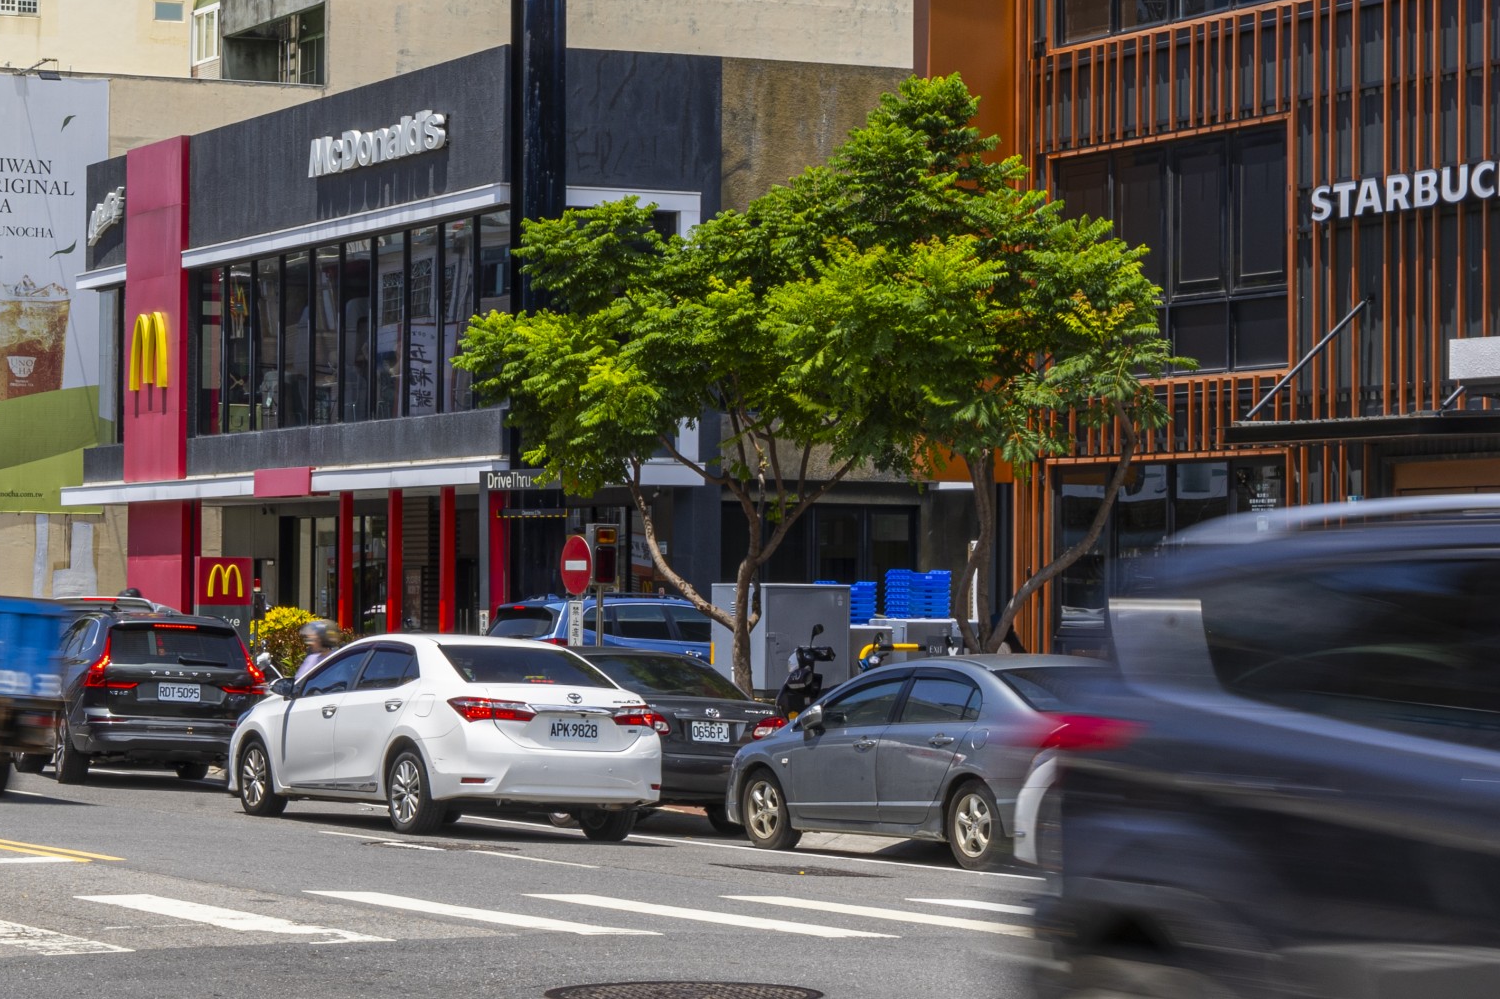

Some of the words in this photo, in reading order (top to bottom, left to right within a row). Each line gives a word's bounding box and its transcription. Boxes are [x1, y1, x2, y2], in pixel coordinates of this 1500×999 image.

[308, 109, 447, 178] McDonald's
[1311, 160, 1500, 222] STARBUC
[929, 645, 943, 654] EXIT
[150, 670, 212, 678] VOLVO
[159, 686, 200, 699] RDT-5095
[550, 722, 598, 738] APK-9828
[693, 725, 729, 739] 0656-PJ
